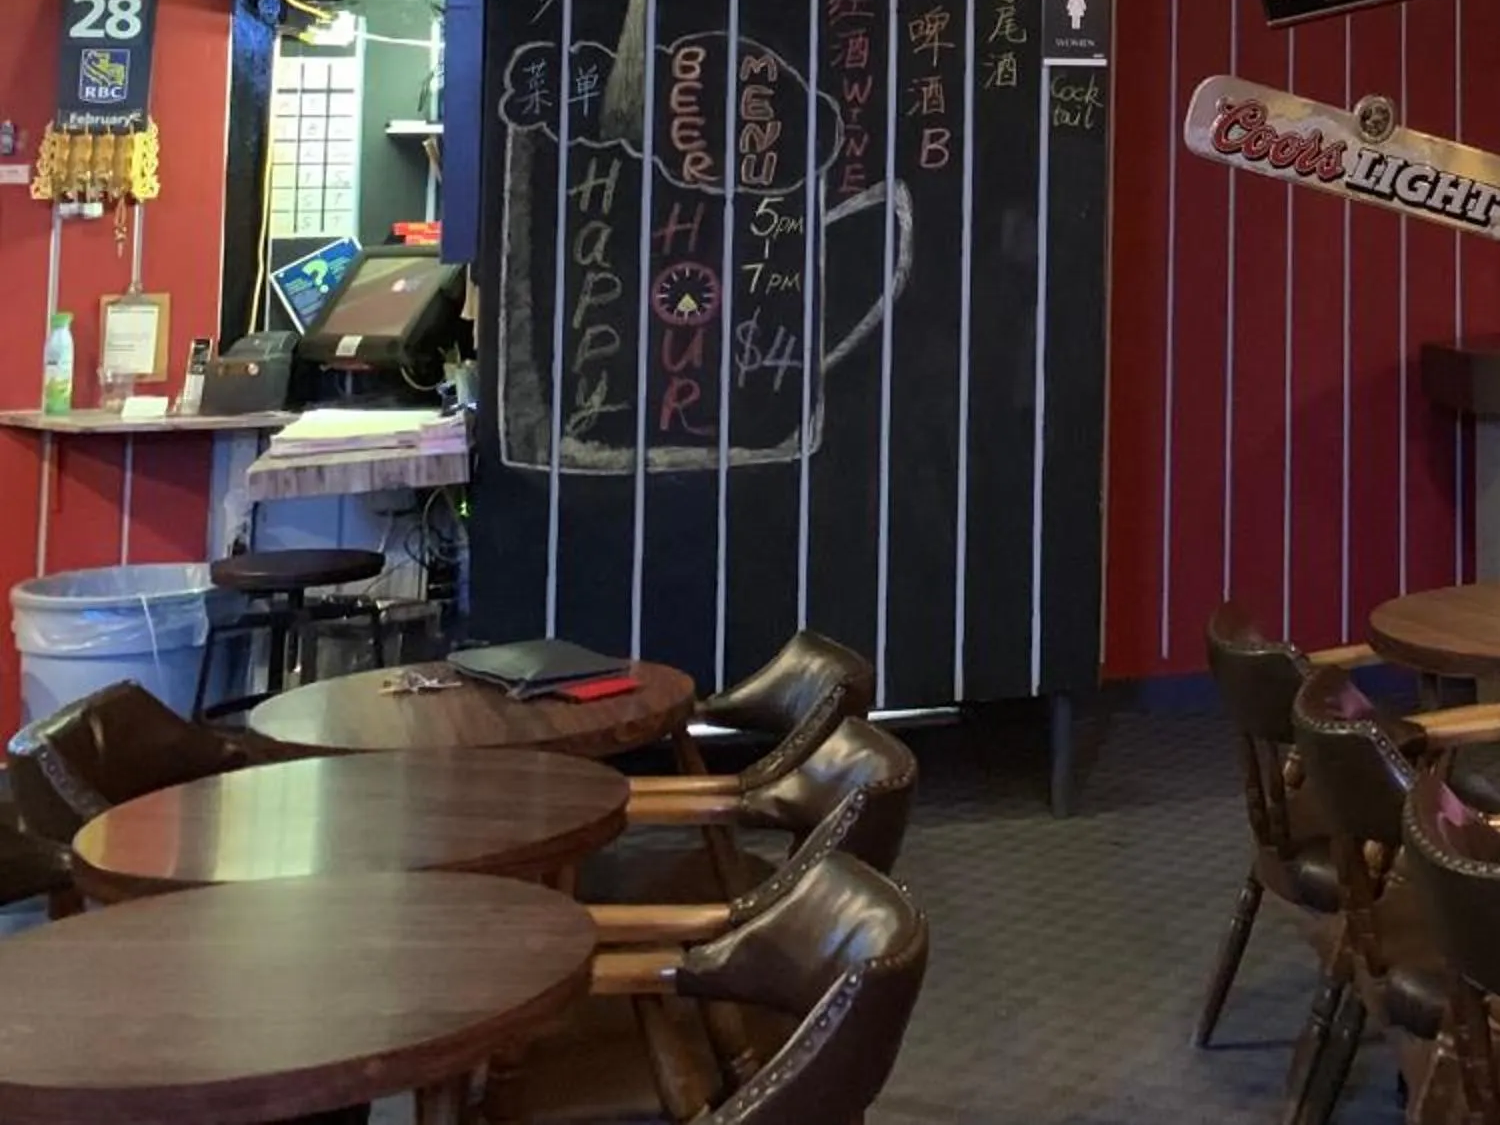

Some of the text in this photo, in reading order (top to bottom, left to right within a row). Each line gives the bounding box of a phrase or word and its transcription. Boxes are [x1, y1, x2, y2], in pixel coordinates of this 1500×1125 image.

[69, 112, 132, 128] February
[85, 86, 123, 99] RBC
[669, 46, 720, 184] BEER
[738, 54, 782, 186] MENU
[839, 76, 874, 194] WINE
[920, 128, 950, 168] B
[1210, 95, 1348, 182] Coors
[734, 307, 801, 392] $4
